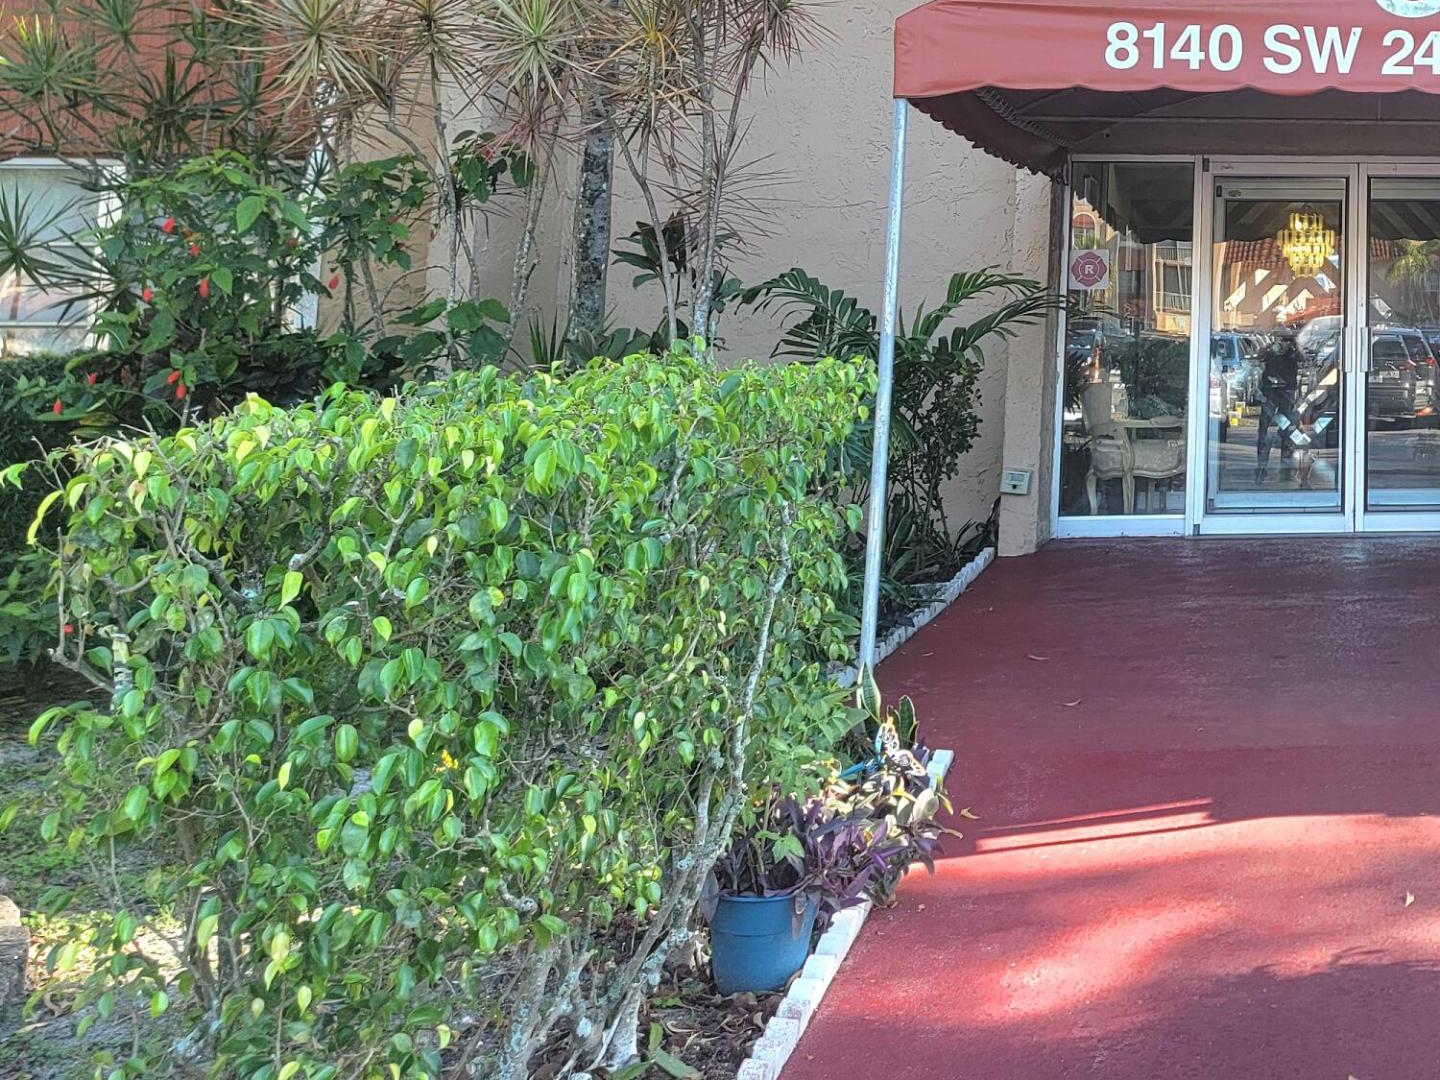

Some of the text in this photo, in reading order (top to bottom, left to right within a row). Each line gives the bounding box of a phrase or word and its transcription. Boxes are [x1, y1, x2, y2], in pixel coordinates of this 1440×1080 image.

[1104, 21, 1243, 71] 8140
[1262, 23, 1363, 75] SW
[1084, 264, 1095, 275] R
